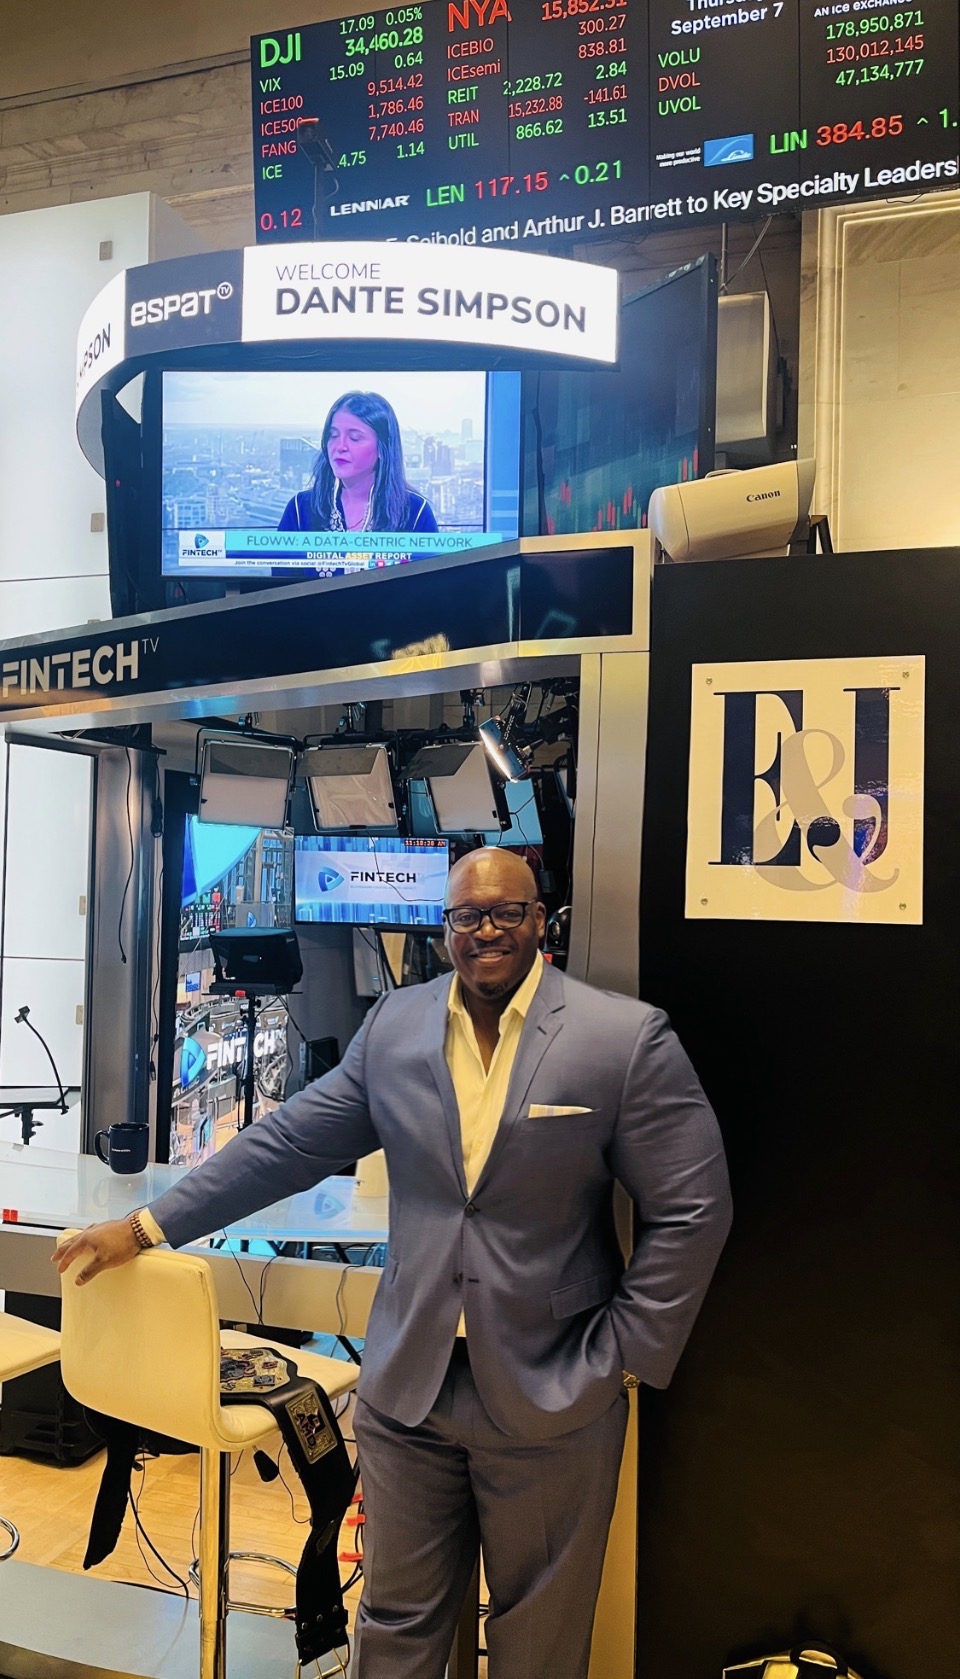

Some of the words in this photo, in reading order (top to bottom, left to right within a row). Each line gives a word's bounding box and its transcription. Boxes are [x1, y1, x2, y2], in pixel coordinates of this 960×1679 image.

[339, 16, 375, 35] 17.09
[386, 6, 423, 26] 0.05%
[447, 0, 513, 32] NYA
[578, 14, 627, 36] 300.27
[670, 5, 768, 36] September
[773, 2, 784, 18] 7
[814, 7, 829, 17] AN
[826, 10, 925, 40] 178,950,871
[260, 33, 302, 68] DJI
[345, 26, 424, 57] 34,460.28
[447, 38, 494, 59] ICEBIO
[578, 37, 627, 59] 838.81
[658, 47, 701, 68] VOLU
[826, 34, 925, 64] 130,012,145
[259, 77, 282, 93] VIX
[329, 62, 365, 81] 15.09
[394, 51, 424, 69] 0.64
[447, 59, 501, 82] ICEsemi
[595, 61, 628, 80] 2.84
[658, 72, 701, 92] DVOL
[835, 58, 925, 86] 47,134,777
[260, 95, 304, 115] ICE100
[367, 73, 424, 96] 9,514.42
[447, 86, 479, 104] REIT
[503, 72, 563, 96] 2,228.72
[583, 84, 628, 105] -141.61
[368, 95, 425, 119] 1,786.46
[447, 109, 480, 127] TRAN
[508, 95, 564, 119] 15,232.88
[587, 108, 628, 129] 13.51
[658, 96, 702, 116] UVOL
[261, 140, 298, 158] FANG
[369, 118, 425, 142] 7,740.46
[448, 133, 480, 150] UTIL
[516, 119, 564, 140] 866.62
[769, 129, 808, 155] LIN
[815, 114, 904, 147] 384.85
[262, 164, 283, 180] ICE
[337, 150, 367, 169] 4.75
[397, 141, 425, 159] 1.14
[426, 183, 465, 207] LEN
[475, 171, 549, 200] 117.15
[575, 160, 623, 185] 0.21
[481, 220, 519, 243] and
[523, 215, 586, 238] Arthur
[588, 208, 605, 229] J.
[610, 195, 682, 226] Barrett
[687, 195, 708, 214] to
[713, 187, 753, 211] Key
[757, 171, 860, 204] Specialty
[864, 155, 959, 187] Leaders
[260, 208, 303, 231] 0.12
[275, 263, 381, 281] WELCOME
[275, 286, 405, 315] DANTE
[417, 287, 587, 333] SIMPSON
[746, 489, 781, 503] Canon
[247, 535, 299, 546] FLOWW:
[302, 536, 311, 546] A
[314, 536, 406, 547] DATA-CENTRIC
[409, 537, 473, 548] NETWORK
[307, 551, 344, 560] DIGITAL
[345, 552, 374, 560] ASSET
[375, 552, 413, 560] REPORT
[2, 640, 139, 698] FINTECH
[141, 637, 160, 654] TV
[350, 871, 416, 883] FINTECH
[206, 1029, 275, 1071] FINTCH
